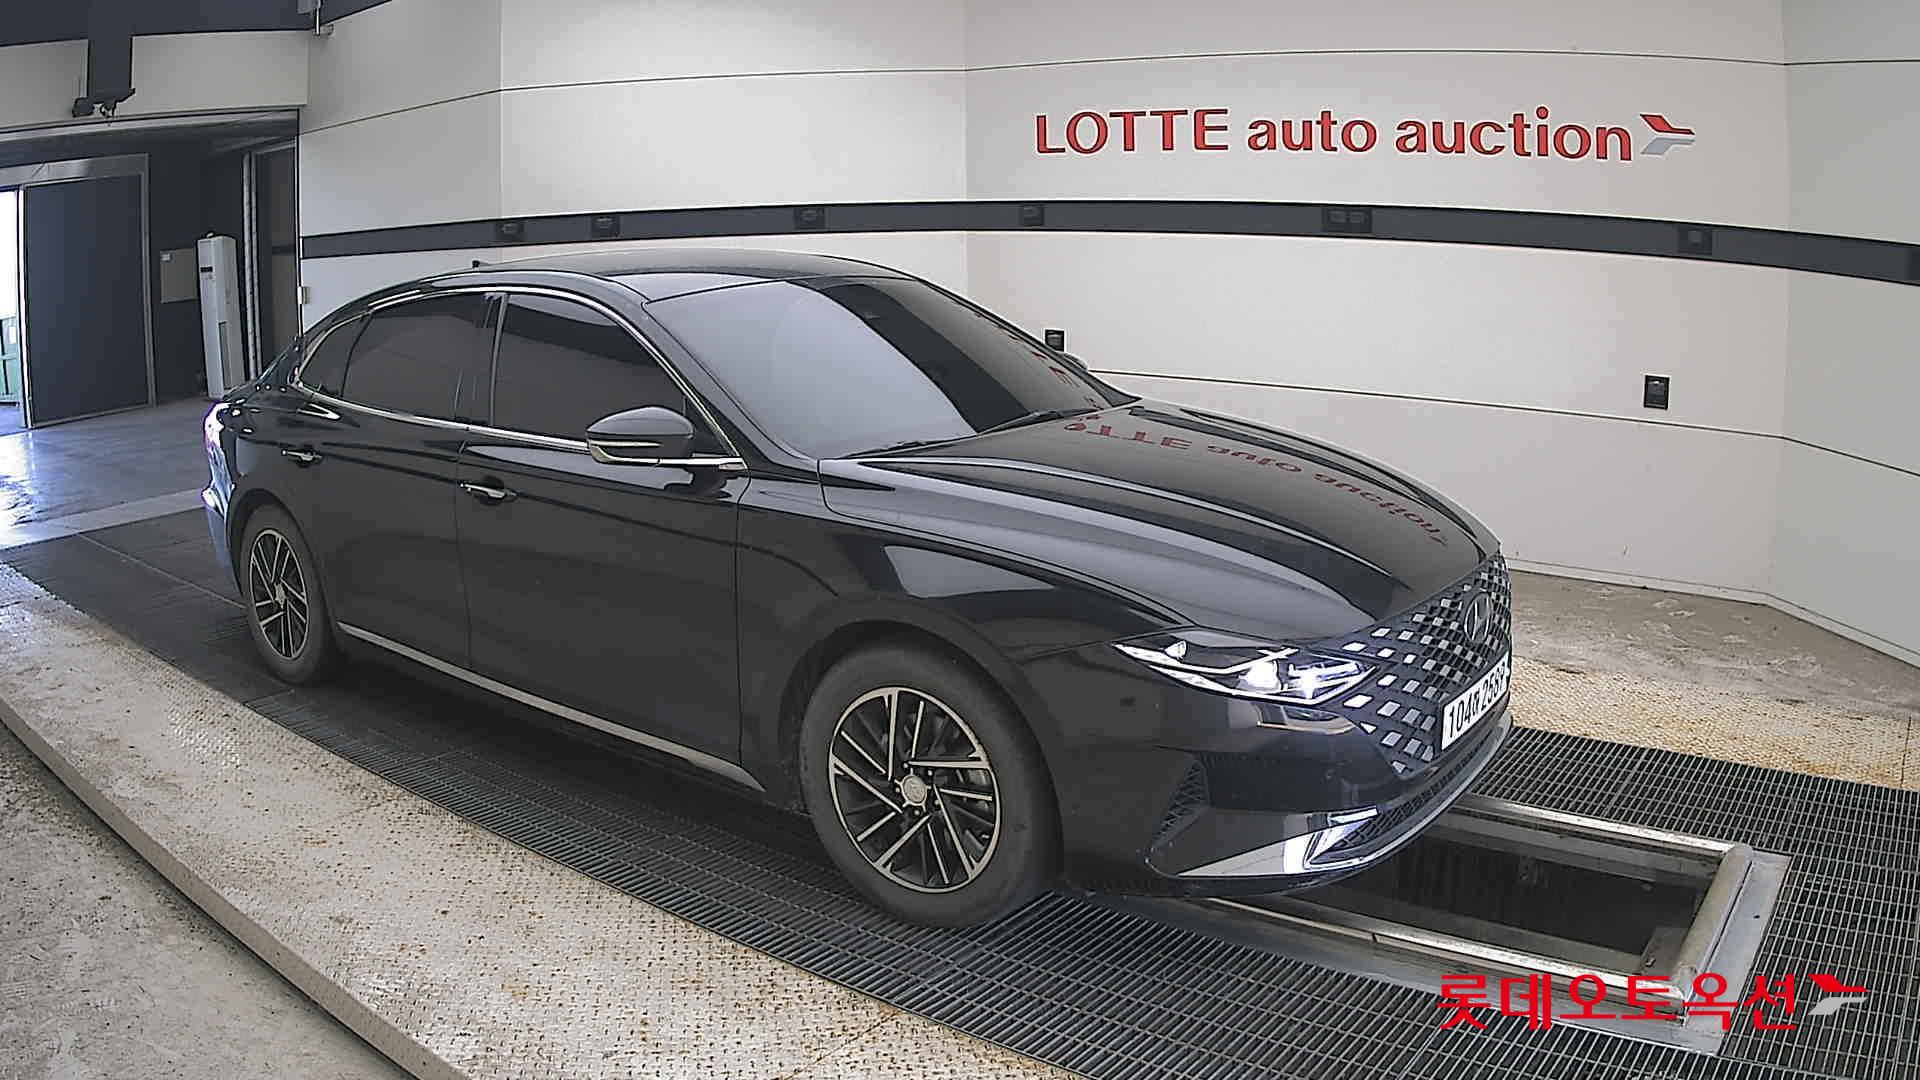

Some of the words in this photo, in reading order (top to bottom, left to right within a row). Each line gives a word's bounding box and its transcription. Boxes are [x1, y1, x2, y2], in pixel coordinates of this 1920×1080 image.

[1036, 108, 1228, 155] LOTTE
[1247, 111, 1377, 153] auto
[1395, 106, 1632, 161] auction
